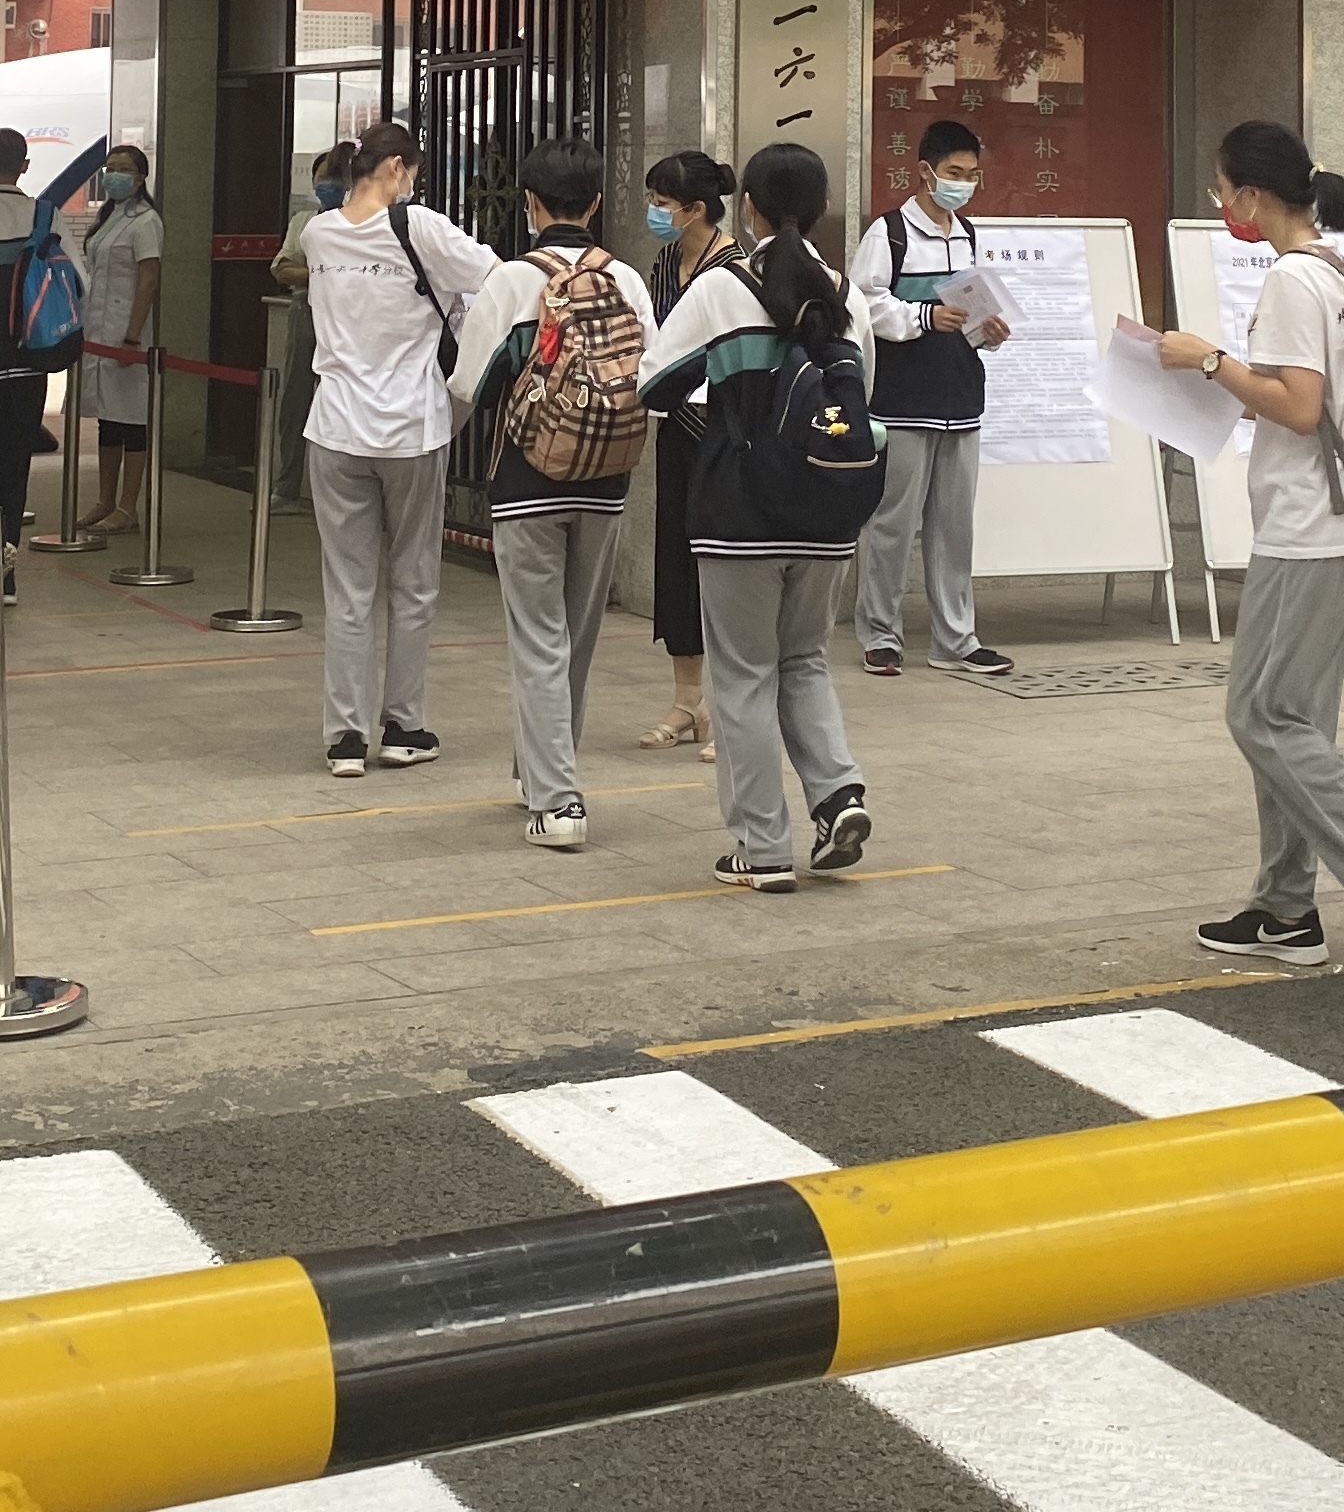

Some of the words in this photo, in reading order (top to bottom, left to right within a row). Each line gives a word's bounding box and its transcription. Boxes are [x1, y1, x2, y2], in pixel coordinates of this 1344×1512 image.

[959, 56, 986, 112] 勤学
[885, 131, 913, 191] 善诱
[1033, 135, 1061, 193] 朴实
